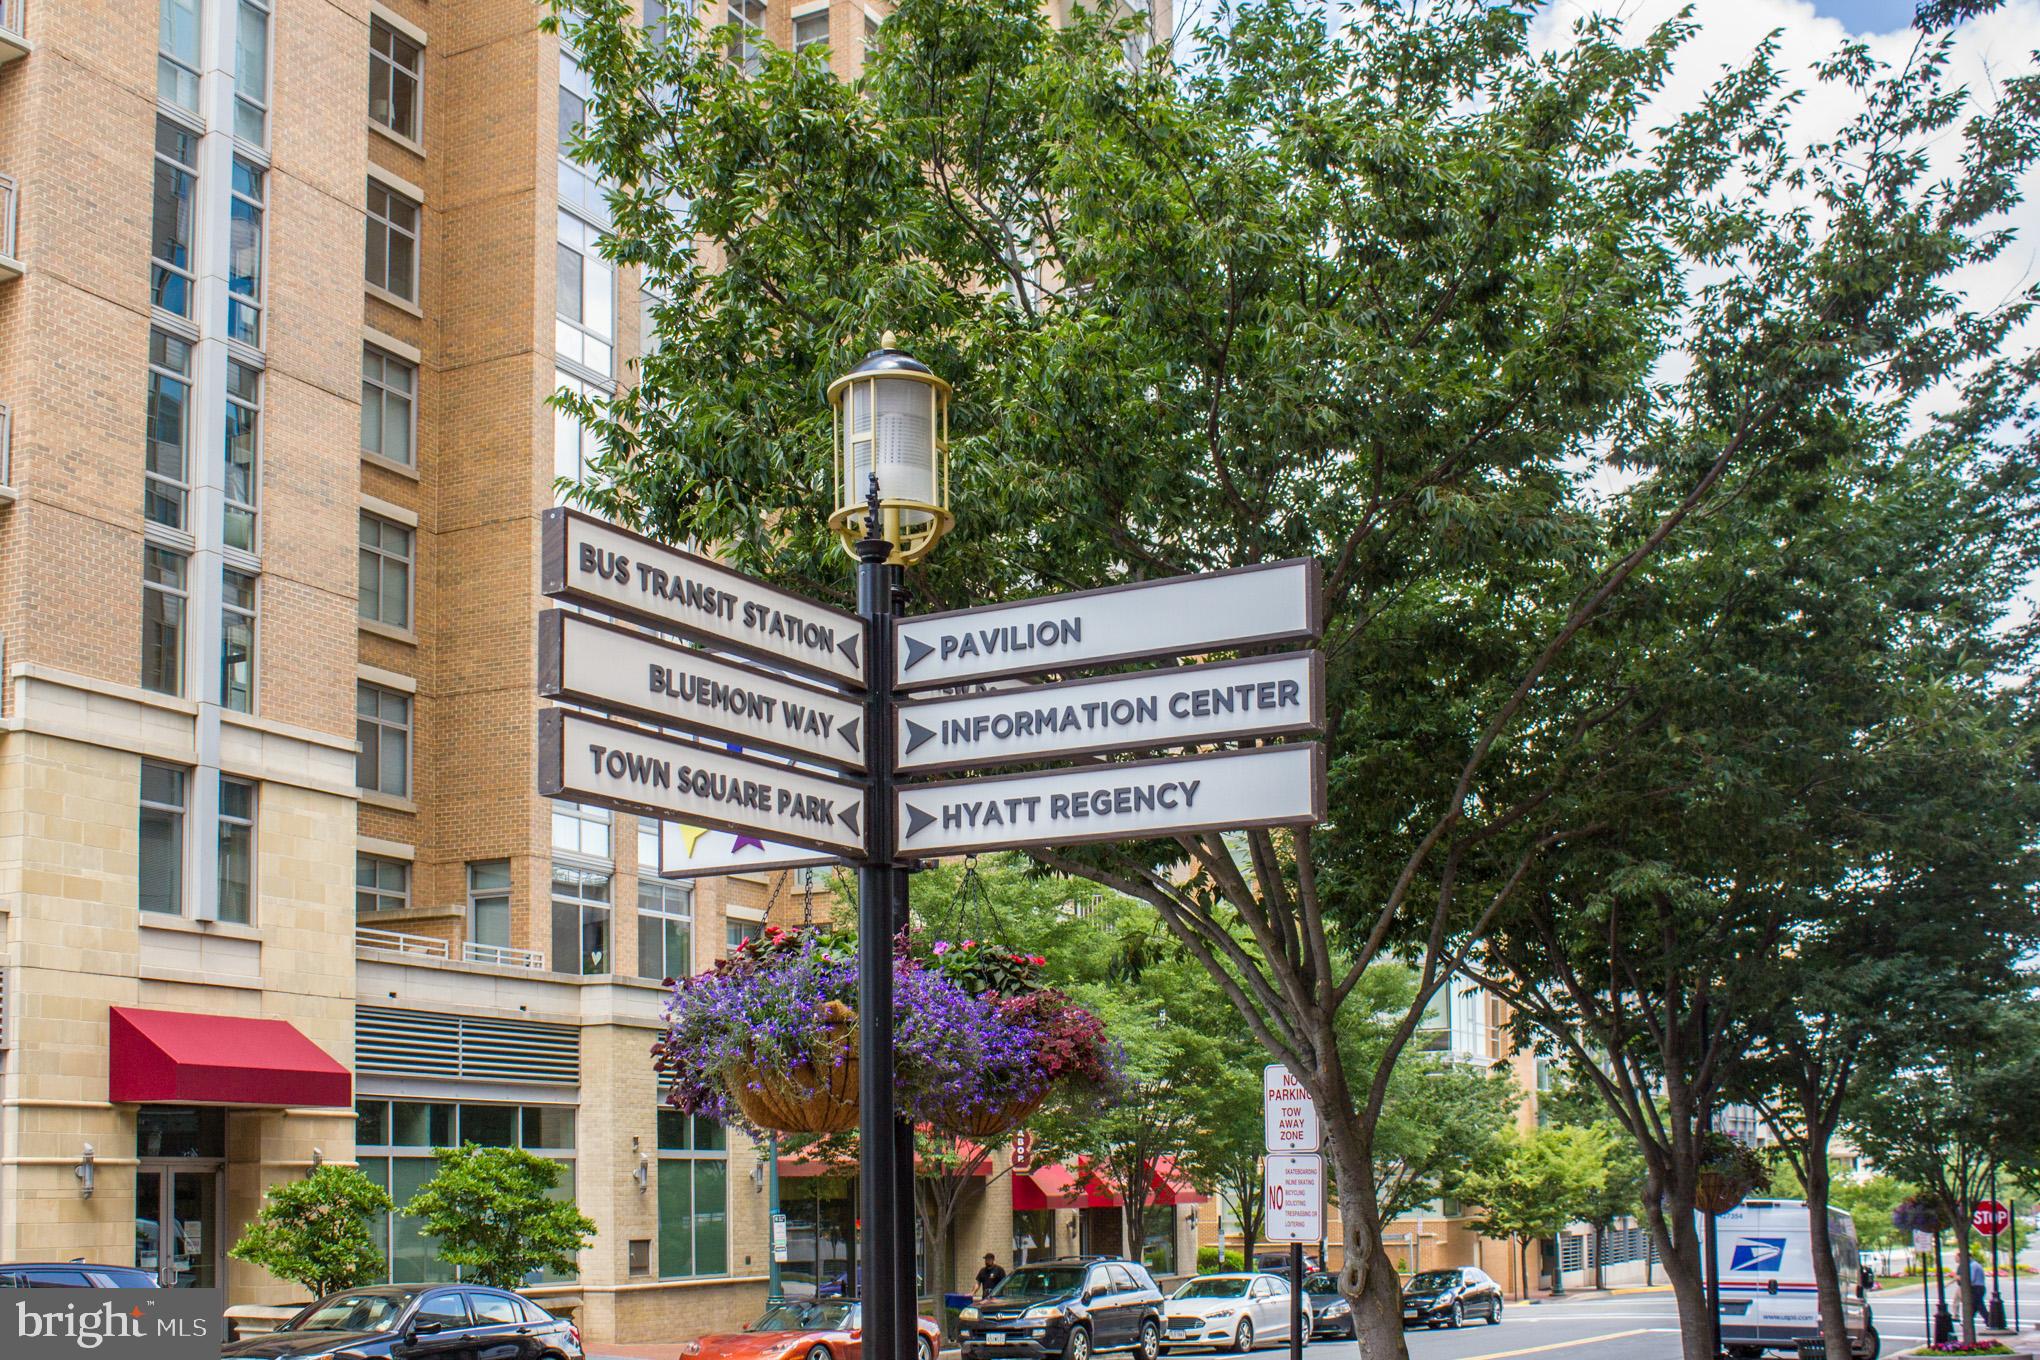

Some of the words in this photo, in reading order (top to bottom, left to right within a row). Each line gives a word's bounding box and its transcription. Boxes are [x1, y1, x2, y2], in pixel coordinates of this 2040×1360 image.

[579, 542, 629, 584] BUS
[637, 562, 737, 620] TRANSIT
[743, 601, 834, 652] STATION
[941, 617, 1081, 660] PAVILION
[650, 664, 777, 723] BLUEMONT
[782, 701, 834, 738] WAY
[942, 696, 1158, 744] INFORMATION
[1169, 680, 1299, 719] CENTER
[590, 744, 670, 789] TOWN
[678, 766, 771, 812] SQUARE
[778, 789, 834, 825] PARK
[942, 796, 1041, 829] HYATT
[1051, 781, 1200, 820] REGENCY
[1283, 1074, 1297, 1086] NO
[1279, 1120, 1304, 1128] AWAY
[1281, 1108, 1301, 1116] TOW
[1280, 1131, 1303, 1140] ZONE
[1269, 1186, 1283, 1210] NO
[1973, 1210, 2008, 1225] STOP
